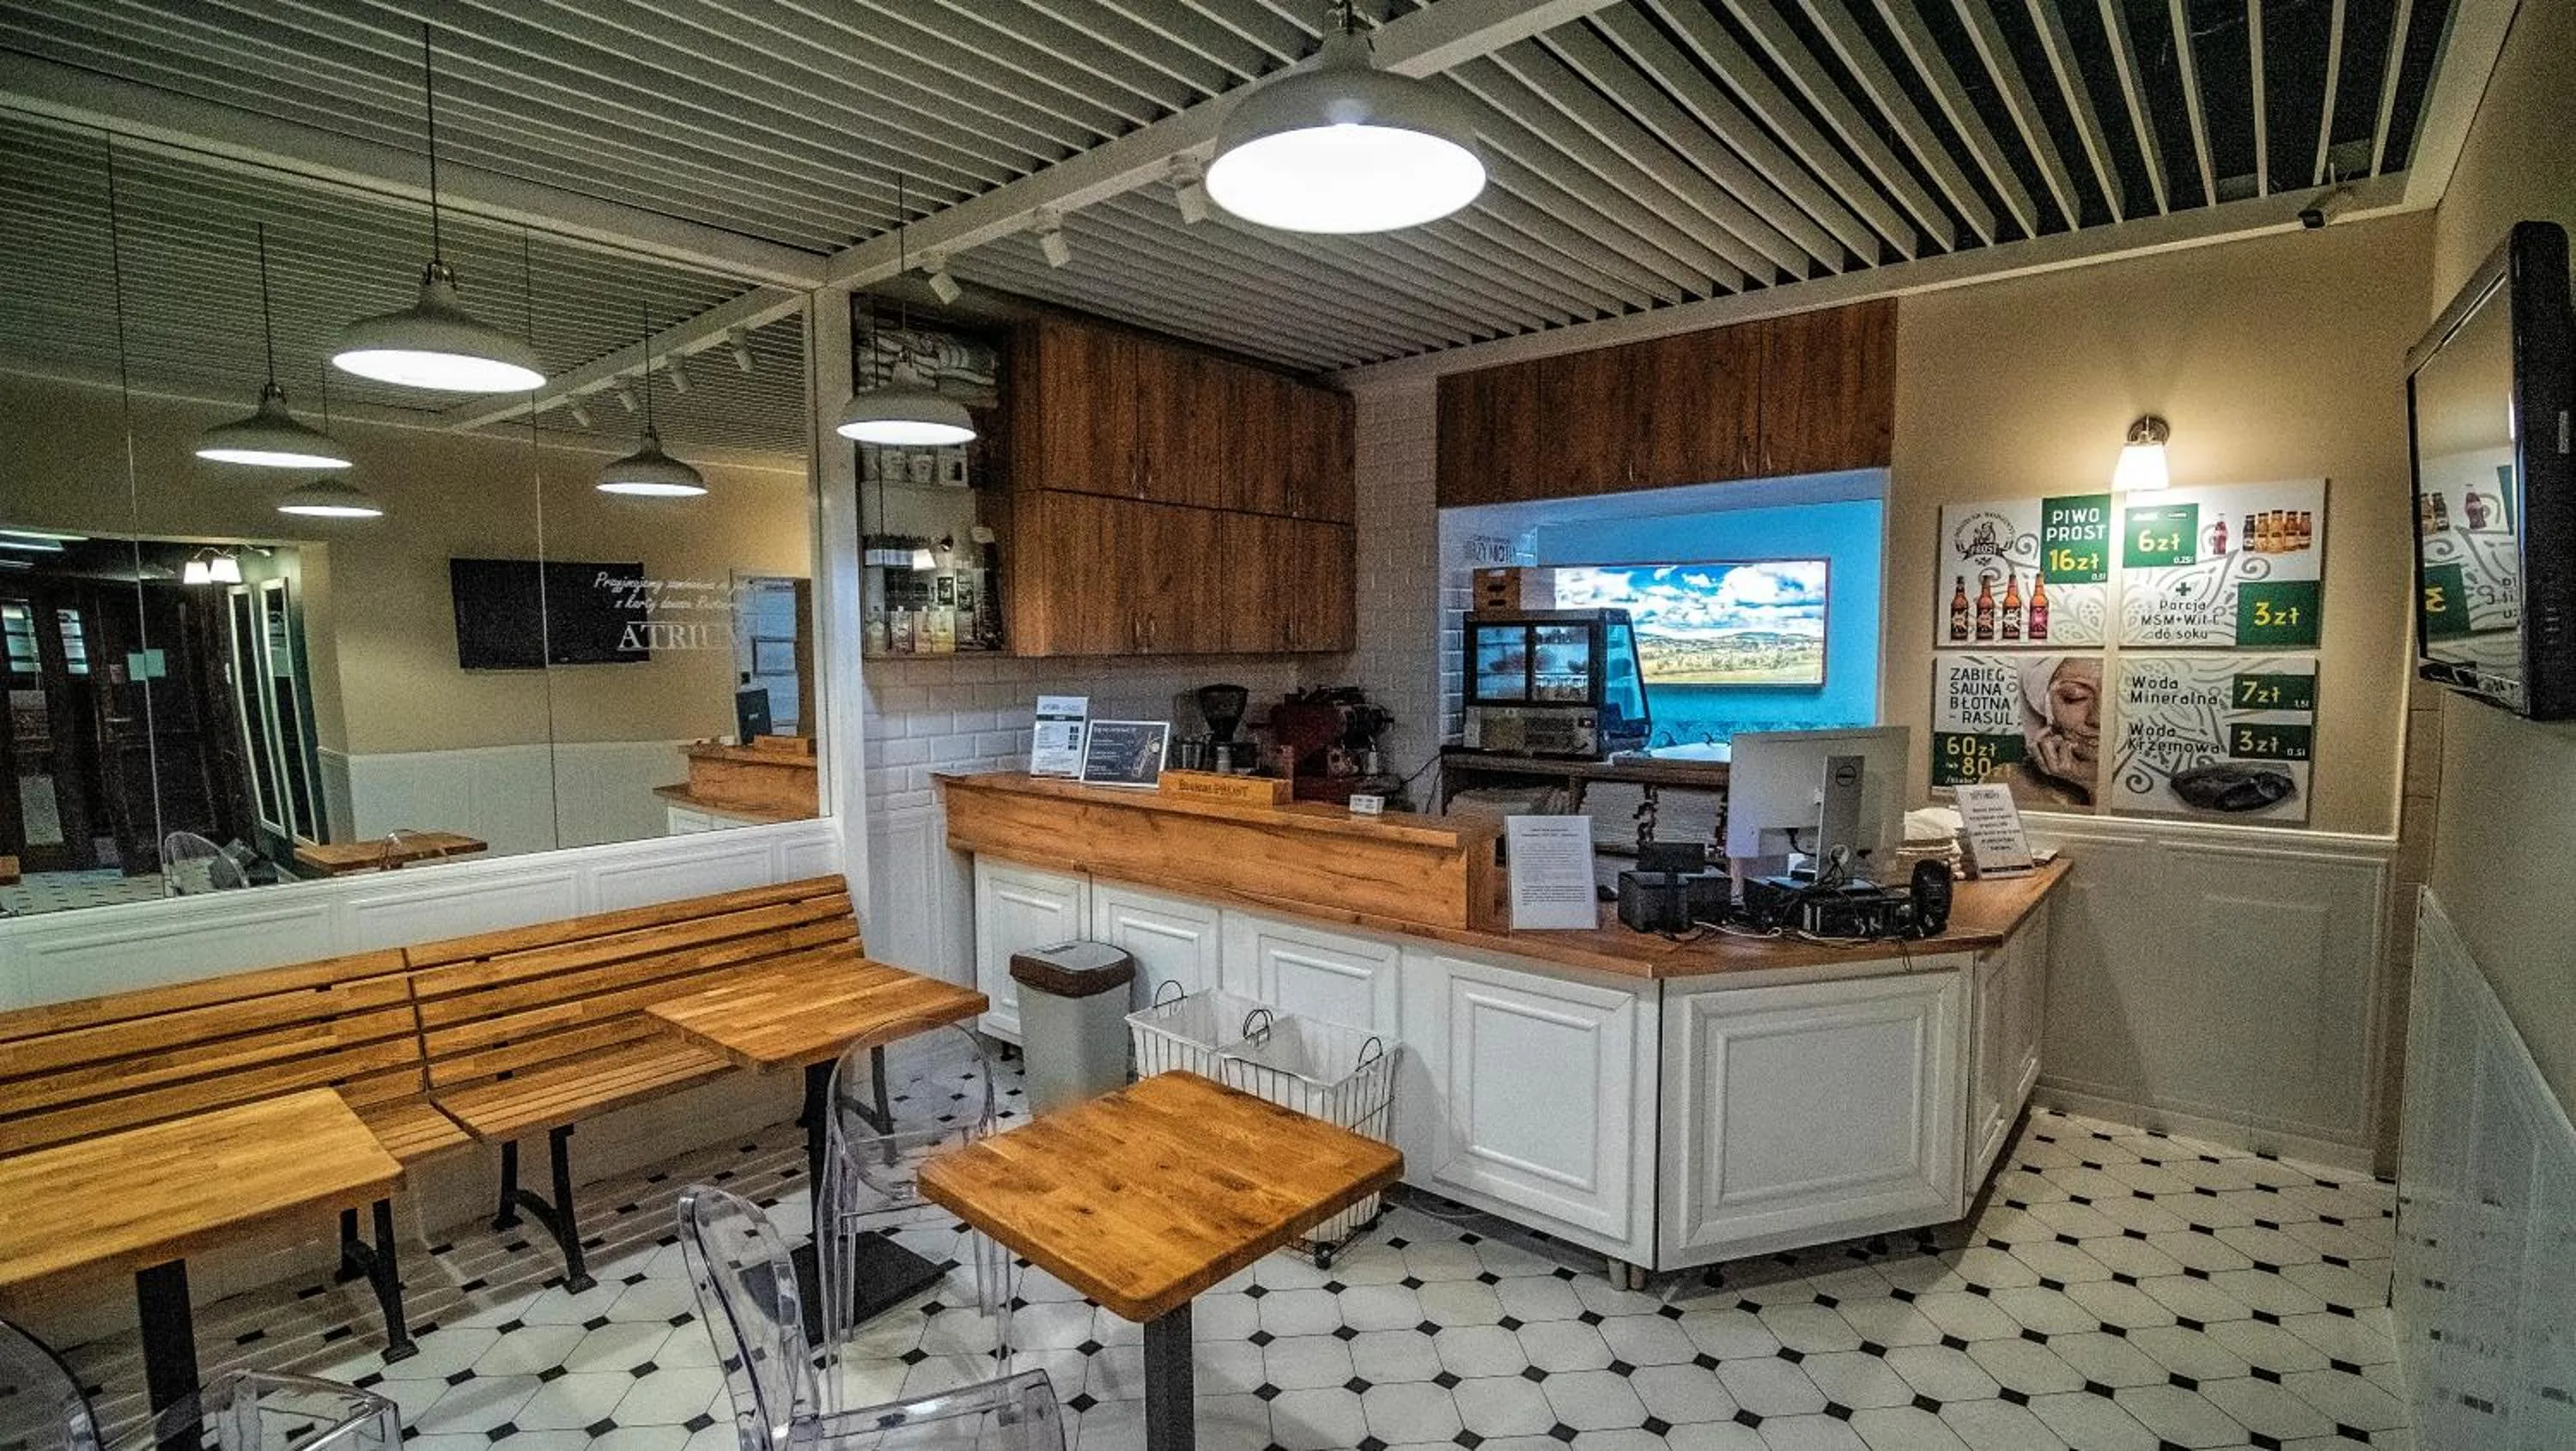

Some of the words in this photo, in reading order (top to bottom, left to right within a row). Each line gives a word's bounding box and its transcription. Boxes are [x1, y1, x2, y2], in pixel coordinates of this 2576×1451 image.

[2052, 507, 2099, 525] PIWO
[2046, 525, 2106, 542] PROST
[2138, 529, 2181, 552] 6zł
[2050, 549, 2099, 571] 16zł
[2160, 600, 2207, 611] Porcja
[2254, 602, 2300, 626] 3zł
[2154, 628, 2172, 640] do
[2177, 628, 2208, 640] soku
[1950, 667, 2005, 682] ZABIEG
[2131, 676, 2179, 689] Woda
[1950, 682, 2002, 696] SAUNA
[2130, 690, 2219, 705] Mineralna
[2241, 680, 2281, 703] 7zł
[1950, 696, 2011, 711] BŁOTNA
[1962, 710, 2014, 726] RASUL
[2129, 723, 2177, 738] Woda
[1947, 736, 1997, 756] 60zł
[2127, 737, 2221, 755] Krzemowa
[2239, 730, 2280, 753] 3zł
[1962, 756, 1992, 777] 80
